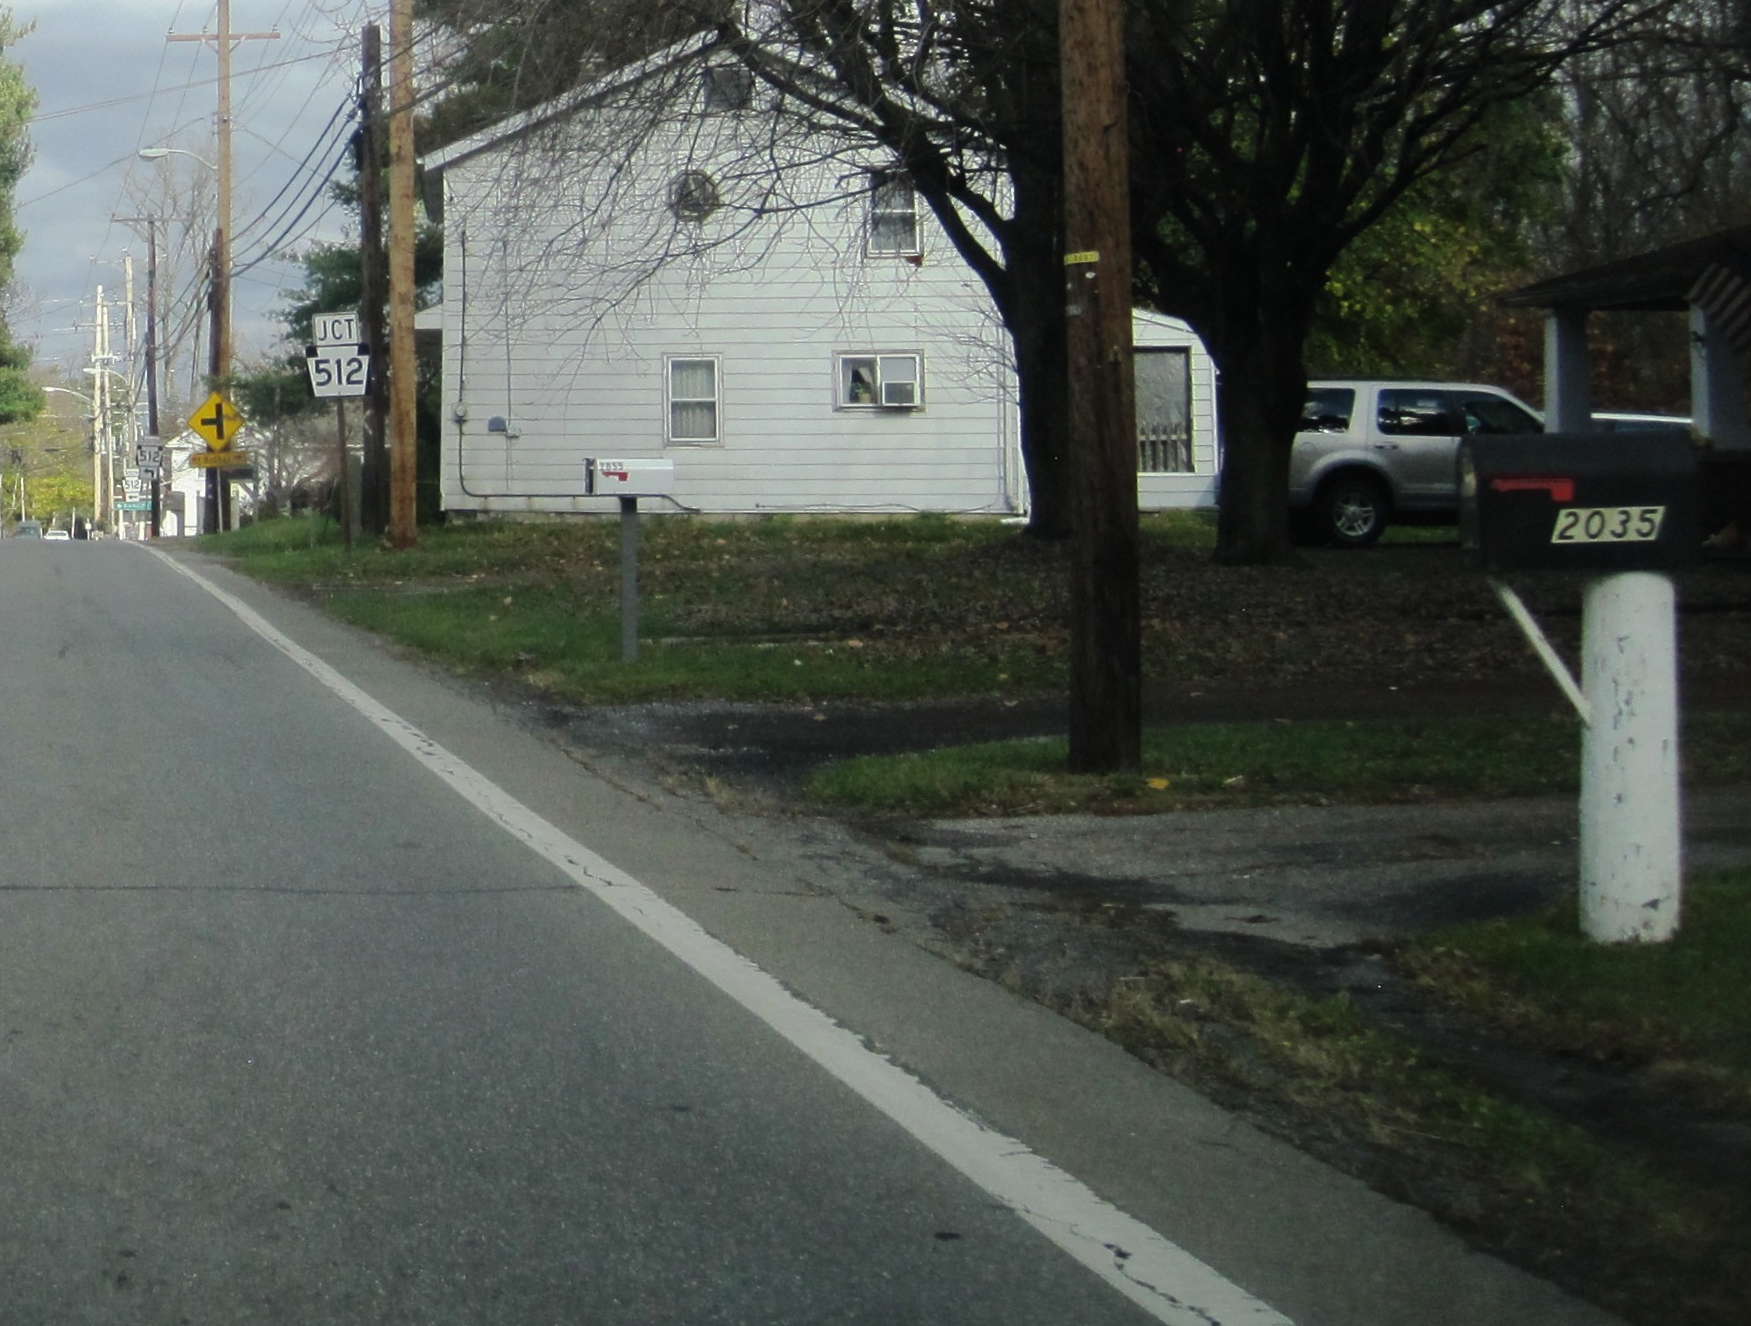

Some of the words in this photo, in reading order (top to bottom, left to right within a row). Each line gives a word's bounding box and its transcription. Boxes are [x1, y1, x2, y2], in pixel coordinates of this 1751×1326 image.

[318, 318, 354, 341] JCT
[315, 357, 364, 386] 512
[139, 450, 159, 462] 512
[125, 479, 140, 489] 512
[1557, 509, 1659, 540] 2035
